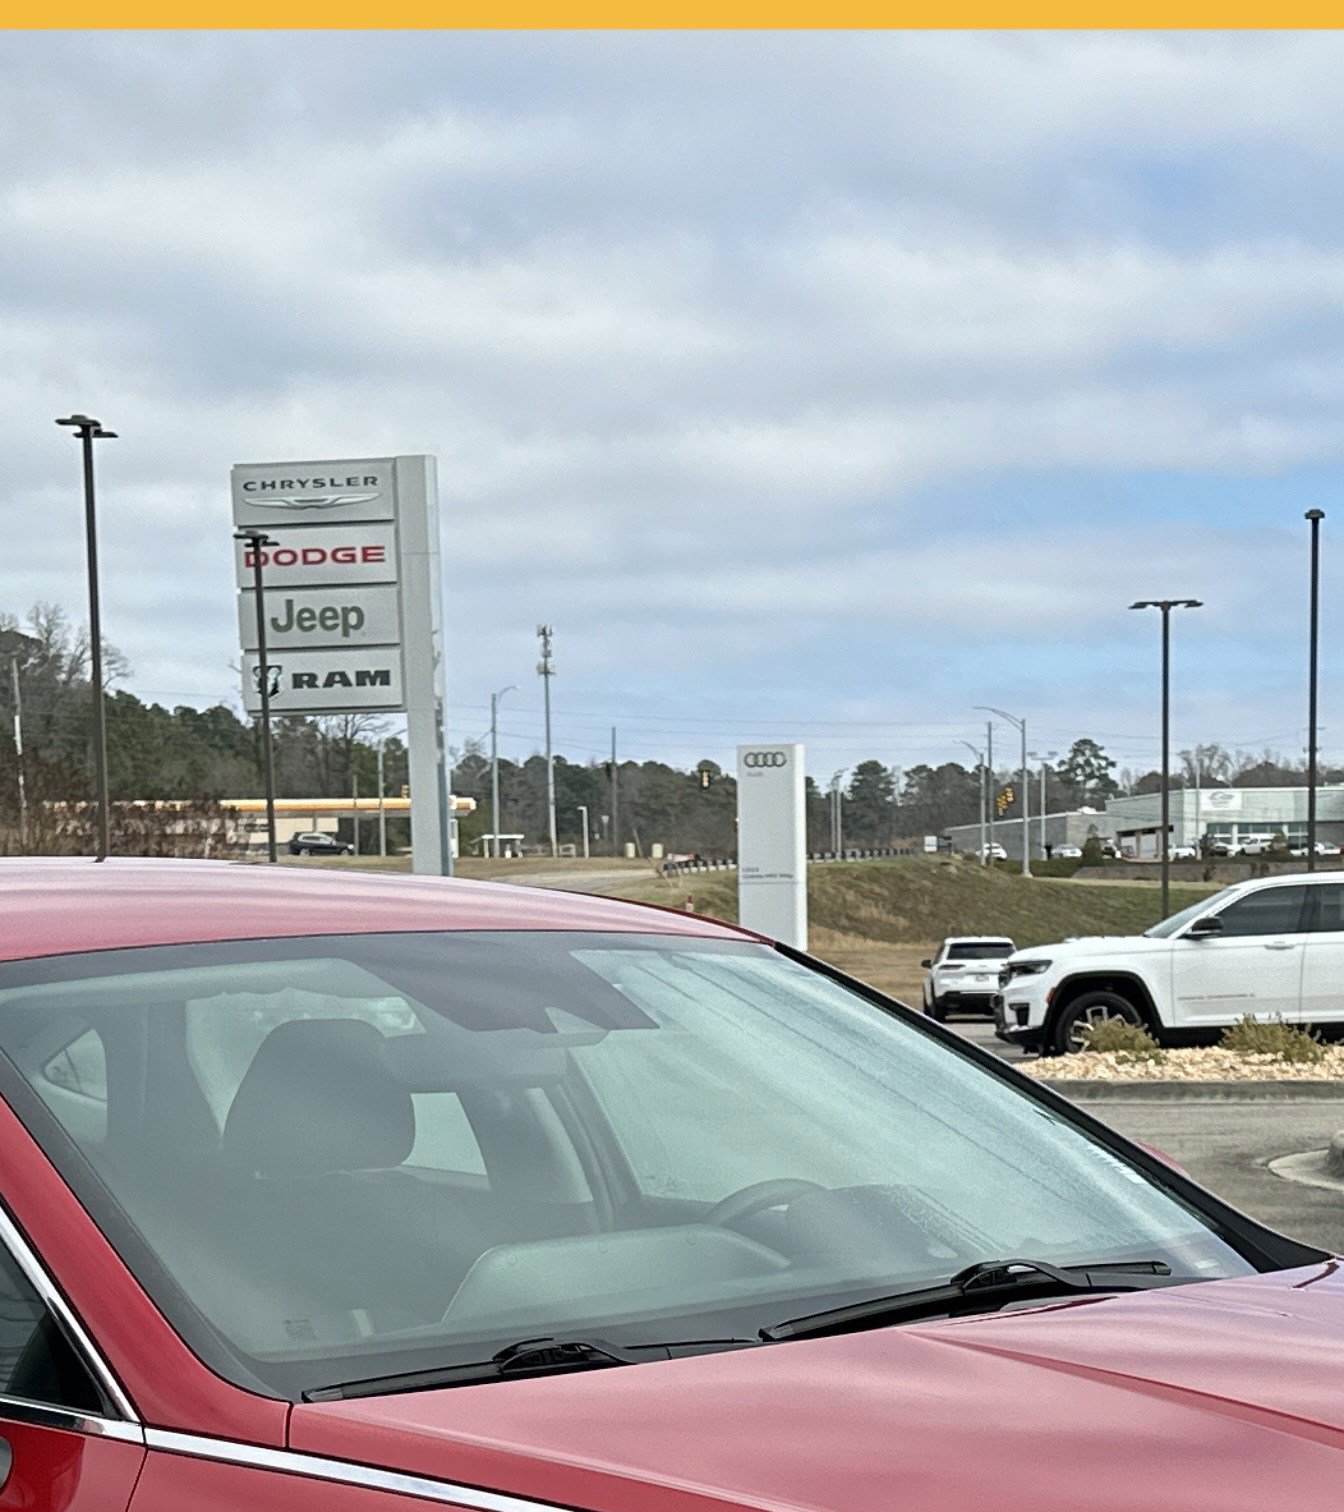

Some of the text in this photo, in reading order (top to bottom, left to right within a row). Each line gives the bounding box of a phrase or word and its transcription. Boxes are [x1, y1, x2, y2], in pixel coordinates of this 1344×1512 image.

[243, 476, 378, 492] CHRYSLER
[244, 546, 386, 568] DODGE
[271, 599, 365, 638] Jeep
[292, 670, 391, 689] RAM
